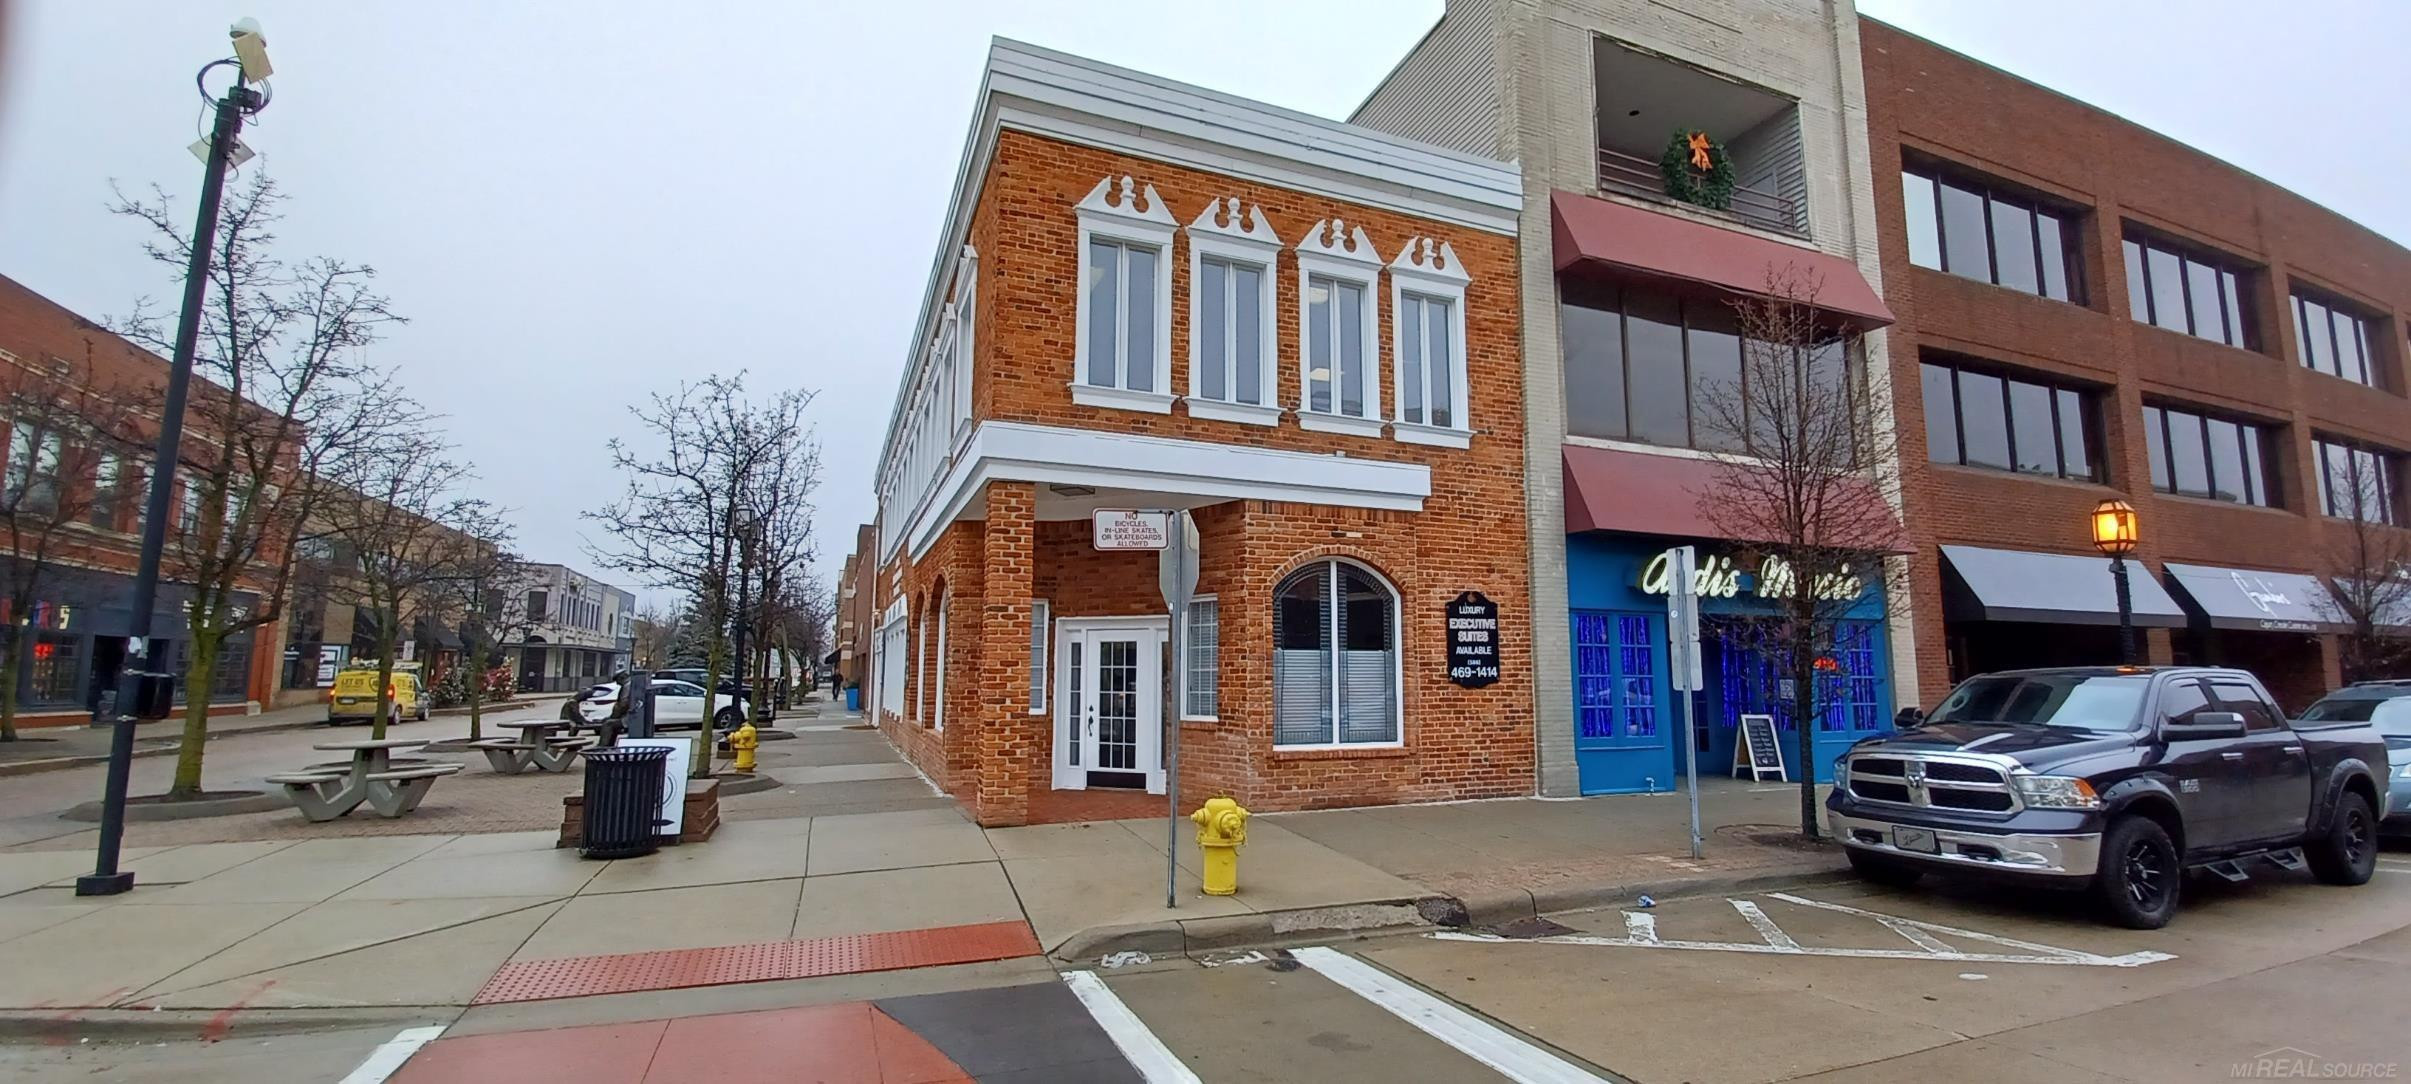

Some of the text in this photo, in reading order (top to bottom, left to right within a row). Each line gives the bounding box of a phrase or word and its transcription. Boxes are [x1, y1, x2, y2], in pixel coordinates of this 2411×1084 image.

[1125, 512, 1138, 520] NO
[1642, 552, 1741, 598] Adis
[1459, 606, 1485, 614] LUXURY
[1449, 618, 1496, 629] EXECUTIVE
[1458, 631, 1488, 642] SUITES
[1456, 646, 1492, 654] AVAILABLE
[1451, 667, 1498, 677] 469-1414
